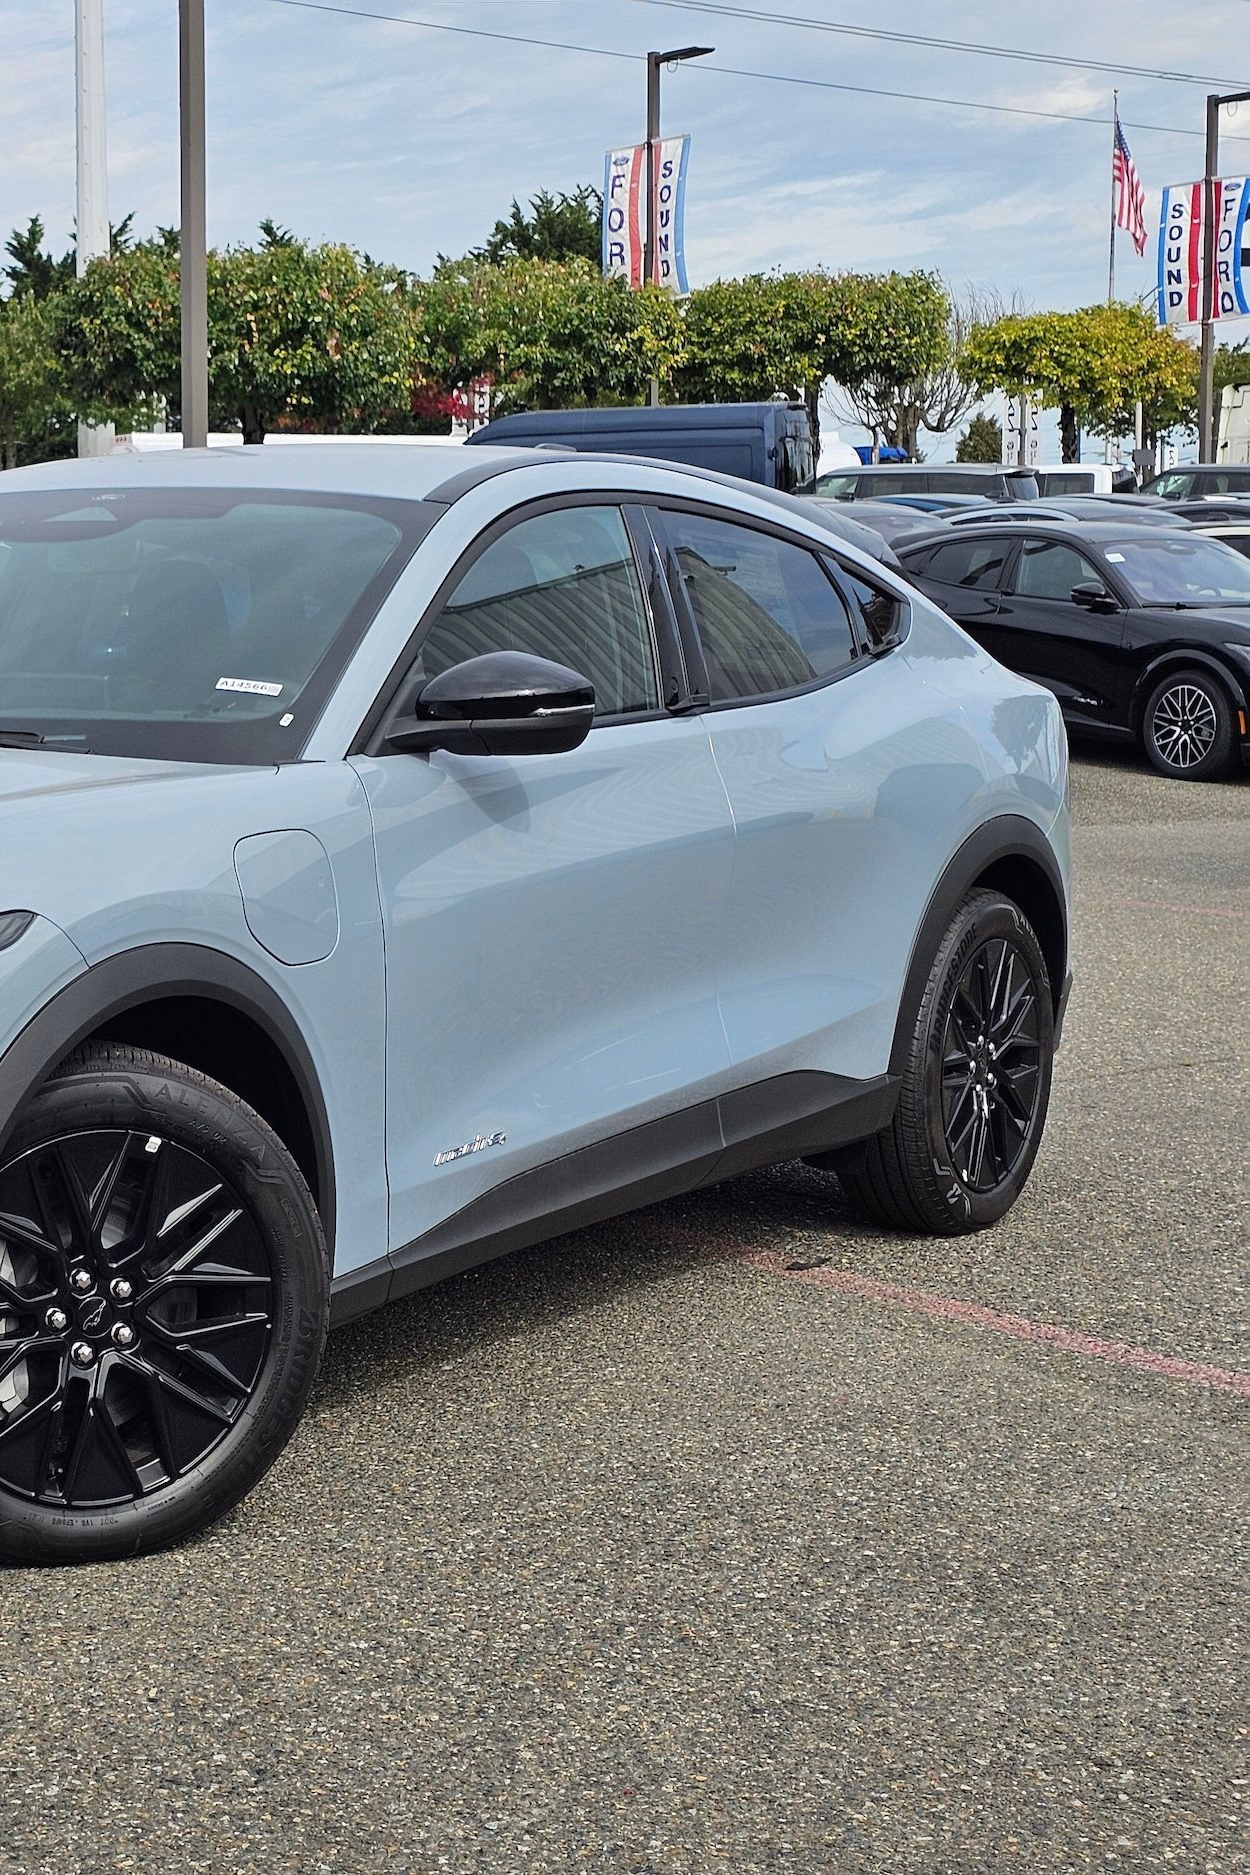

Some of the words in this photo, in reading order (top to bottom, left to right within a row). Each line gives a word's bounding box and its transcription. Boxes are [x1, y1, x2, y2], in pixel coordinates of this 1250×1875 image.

[608, 174, 626, 267] FOR
[659, 160, 673, 278] SOUND
[1167, 203, 1184, 307] SOUND
[1218, 198, 1237, 314] FORD
[154, 1083, 266, 1162] ALENZA
